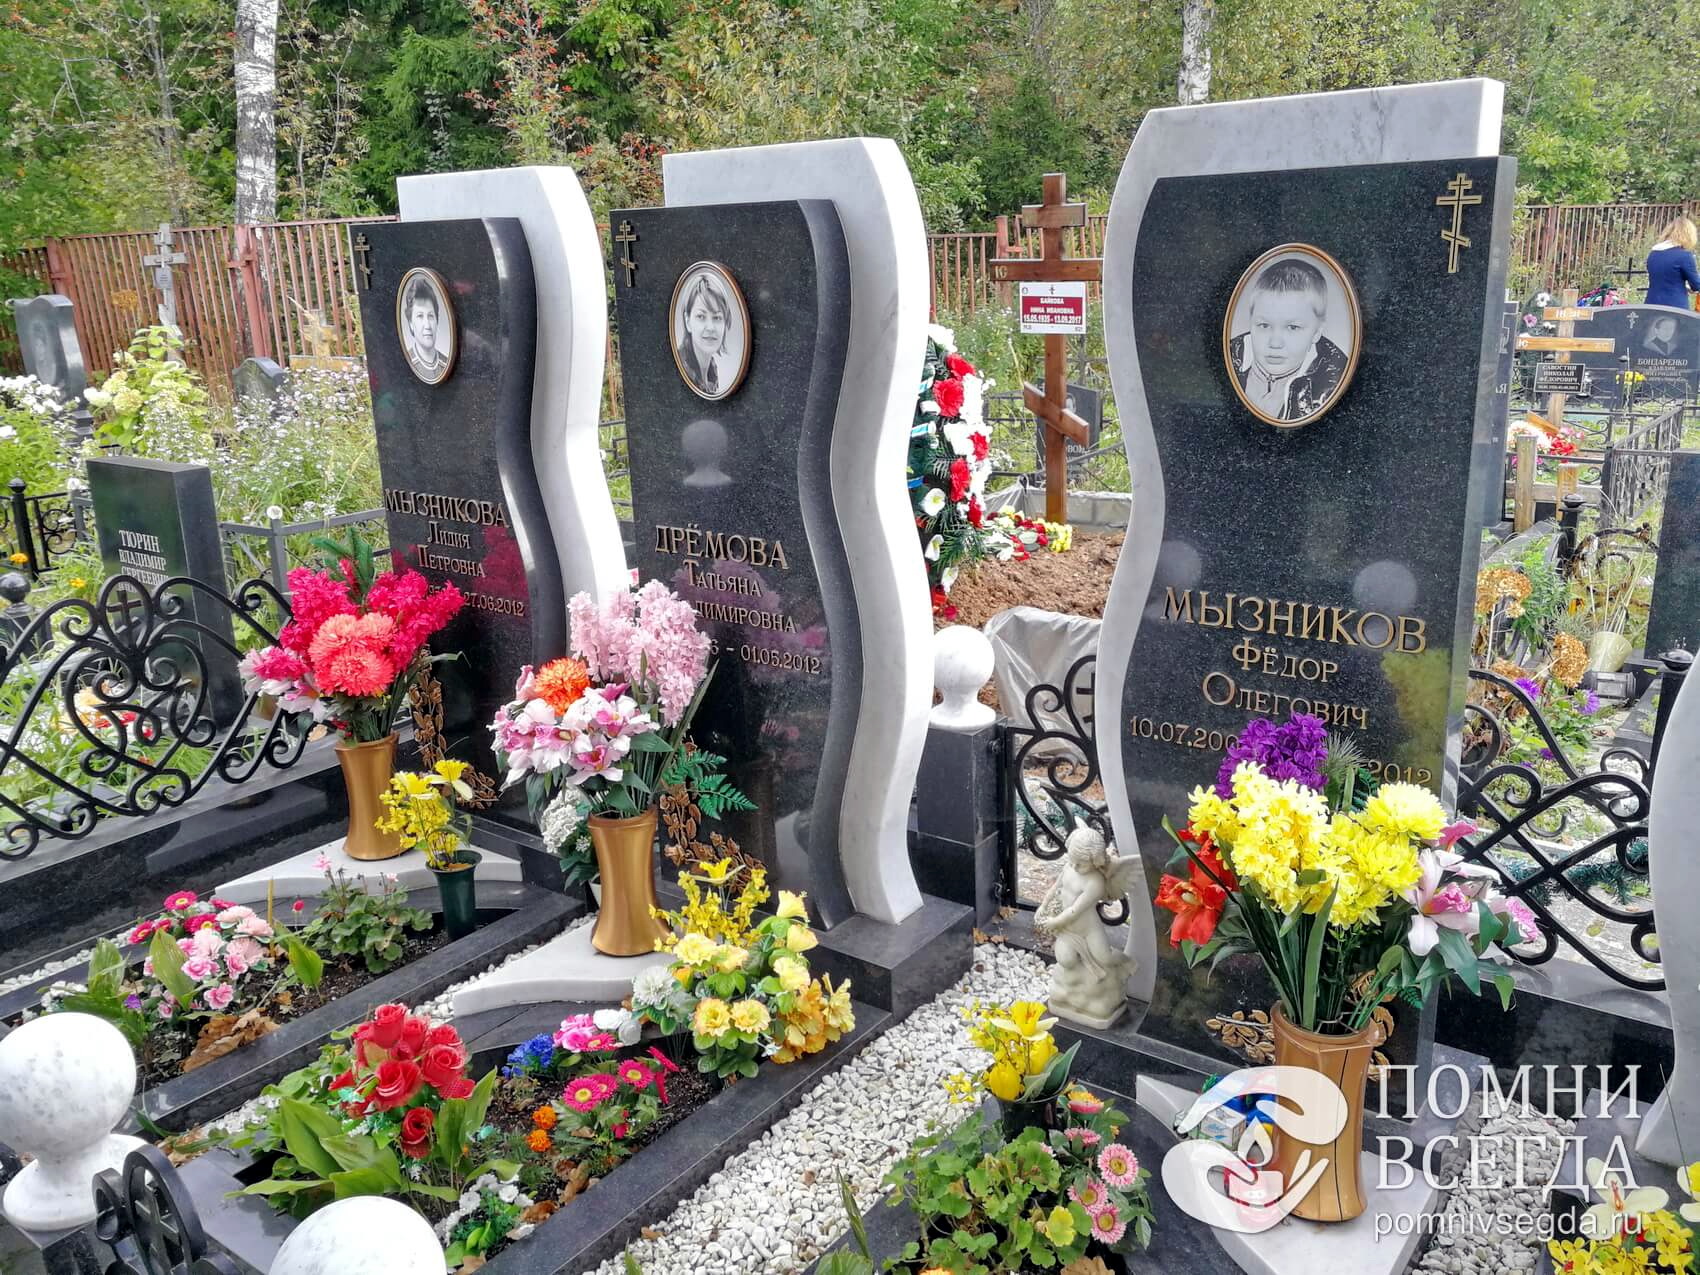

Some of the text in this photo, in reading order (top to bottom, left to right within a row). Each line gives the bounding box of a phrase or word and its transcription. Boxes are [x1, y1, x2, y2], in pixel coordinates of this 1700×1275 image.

[384, 488, 510, 529] МЫЗНИКОВА
[118, 530, 160, 553] ТЮРИН
[118, 549, 167, 571] ВЛАДИМИР
[655, 521, 790, 569] ДРЁМОВА
[463, 591, 524, 617] 27.06.2012
[1160, 586, 1427, 655] МЫЗНИКОВ
[741, 644, 822, 675] 01.05.2012
[1232, 637, 1339, 683] ФЁДОР
[1130, 715, 1241, 752] 10.07.200
